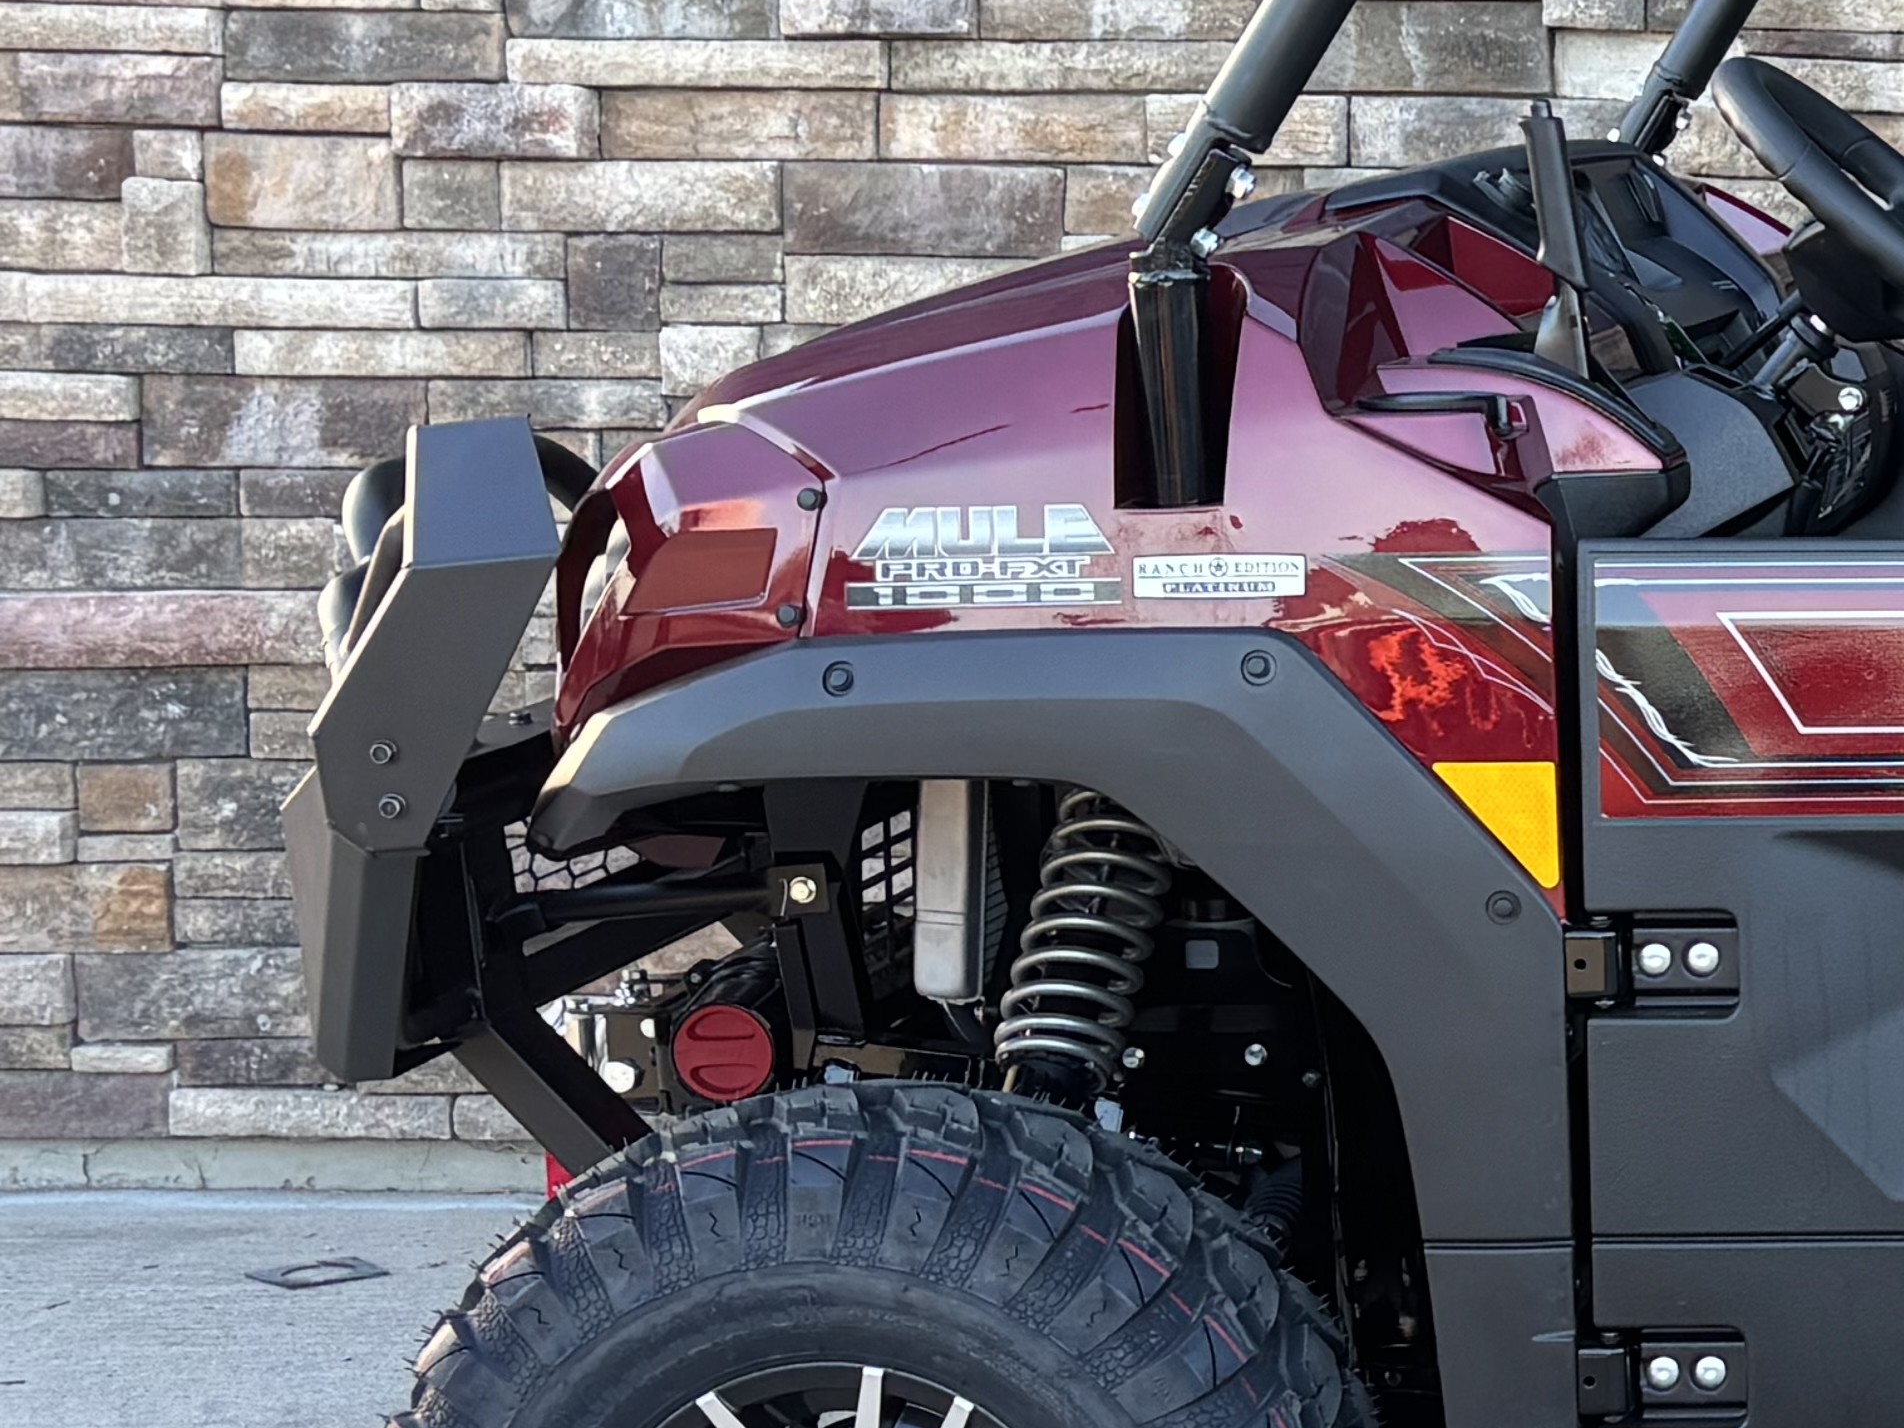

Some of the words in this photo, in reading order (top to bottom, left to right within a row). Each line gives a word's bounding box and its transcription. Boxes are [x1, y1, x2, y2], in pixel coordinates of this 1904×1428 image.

[850, 503, 1116, 559] MULE
[1138, 562, 1203, 575] RANCH
[1234, 561, 1300, 574] EDITION
[872, 582, 1095, 606] 1000
[1163, 581, 1275, 593] PLATINUM
